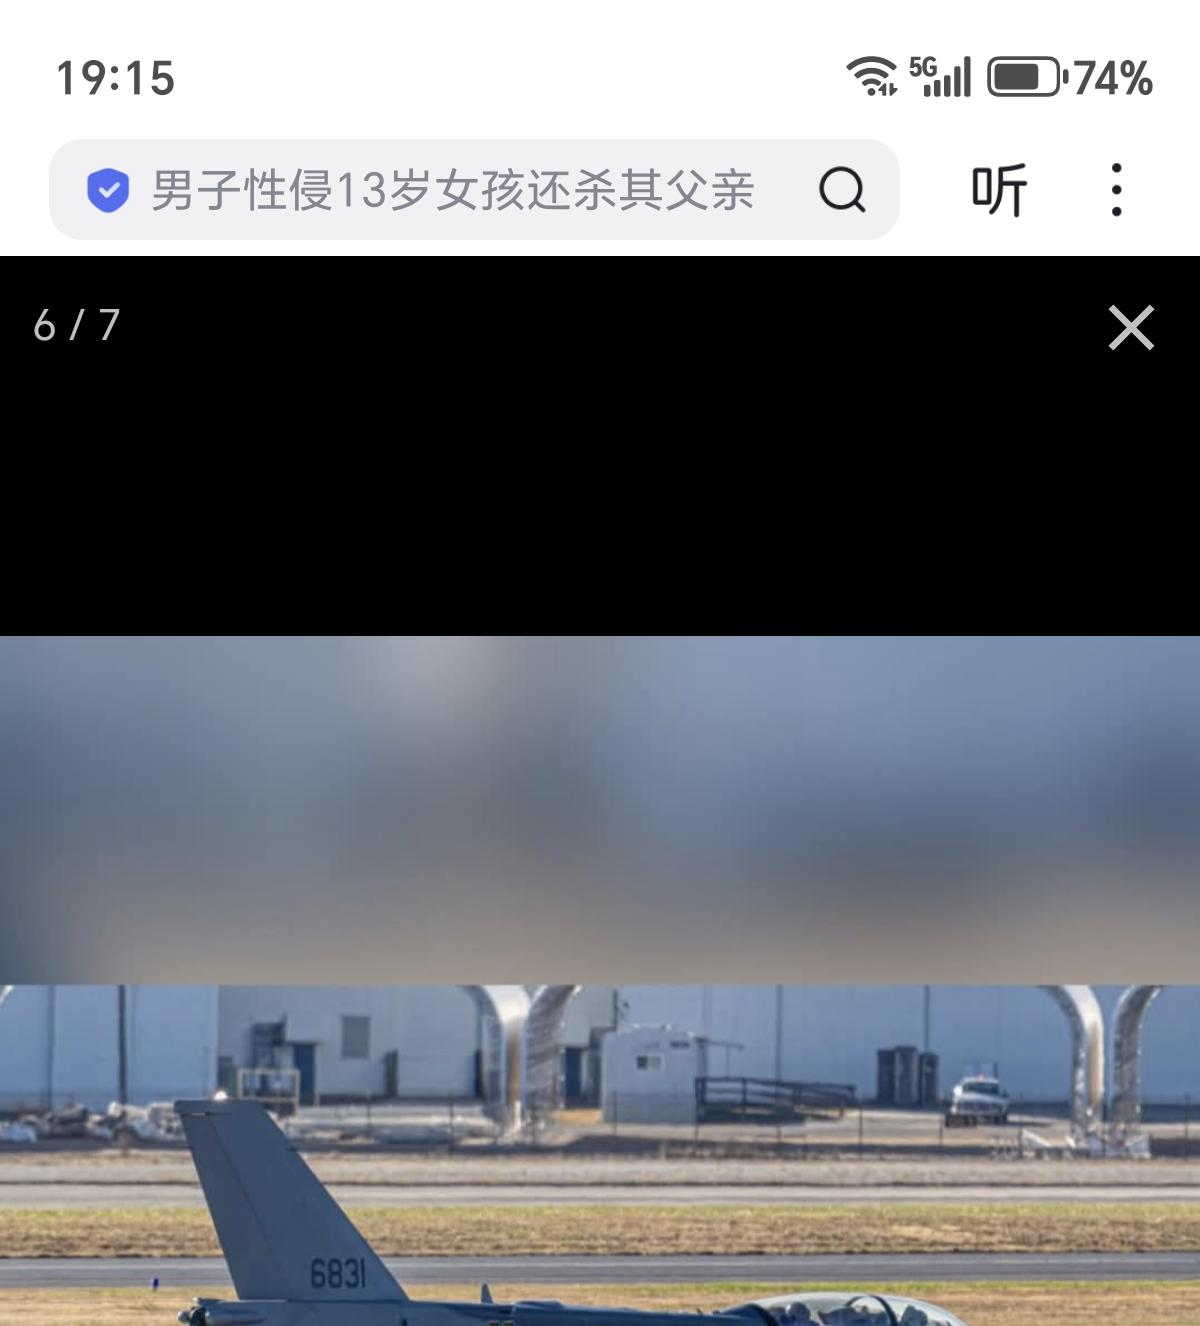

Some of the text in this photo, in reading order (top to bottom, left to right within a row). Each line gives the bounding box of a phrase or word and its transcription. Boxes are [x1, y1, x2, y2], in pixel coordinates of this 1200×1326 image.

[58, 59, 175, 96] 19:15
[909, 55, 938, 78] 5G
[1073, 59, 1154, 96] 74%
[152, 167, 755, 212] 男子性侵13岁女孩还杀其父亲
[972, 162, 1028, 218] 听
[311, 1257, 366, 1290] 6831
